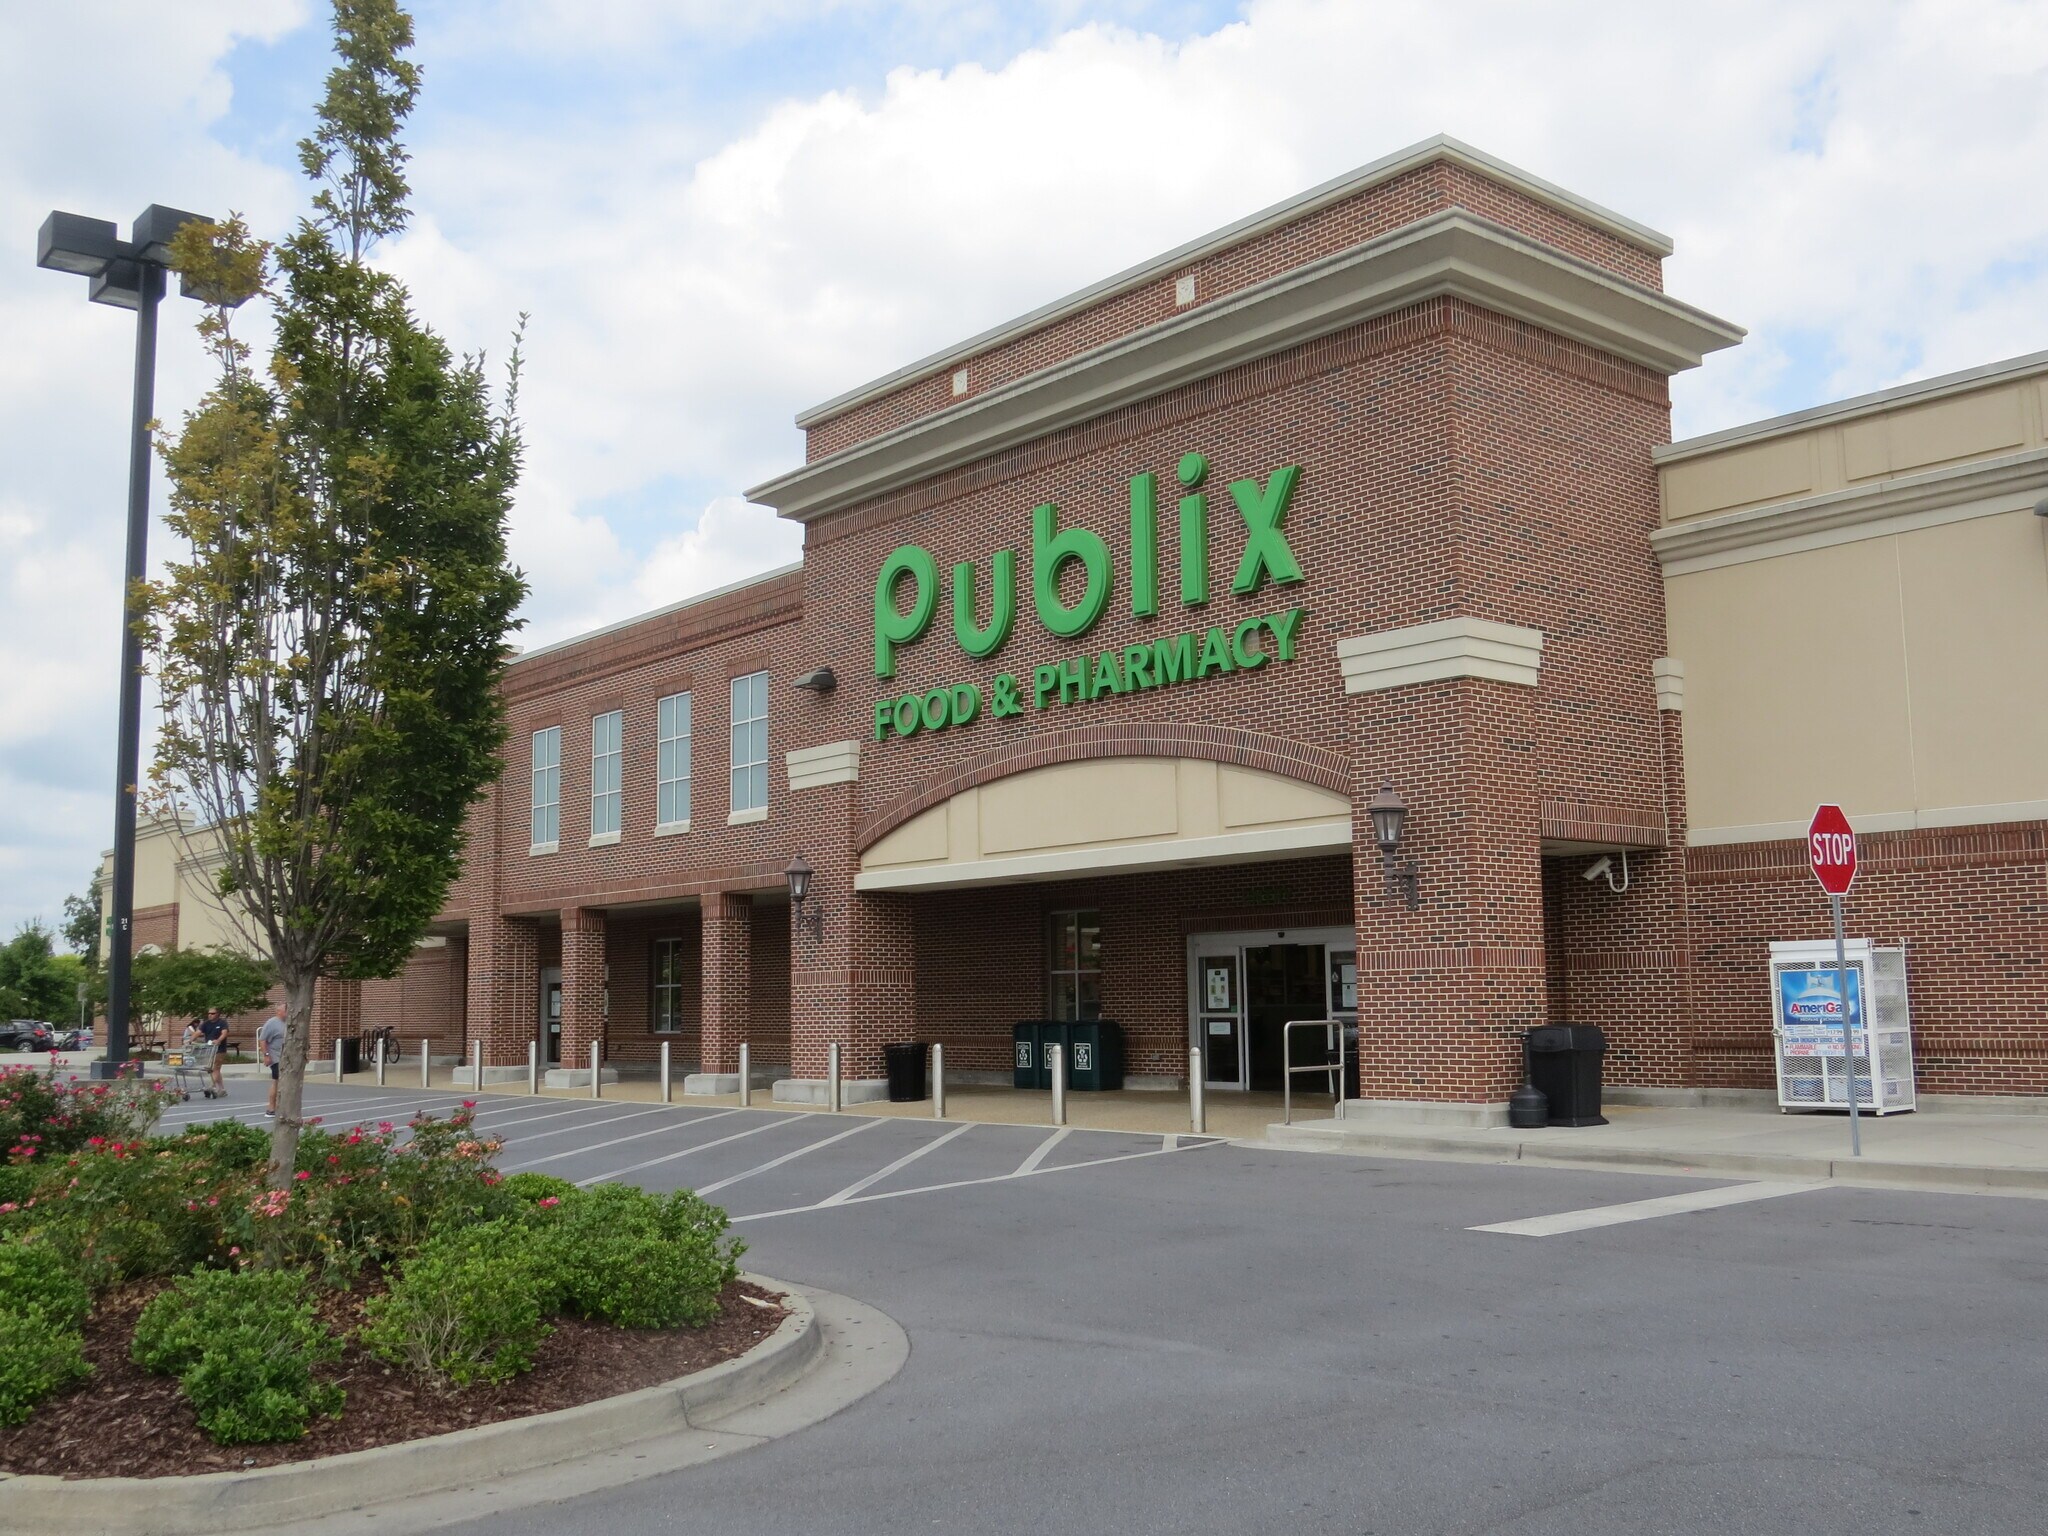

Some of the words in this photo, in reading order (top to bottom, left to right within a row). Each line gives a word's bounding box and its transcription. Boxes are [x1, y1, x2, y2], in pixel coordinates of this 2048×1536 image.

[875, 683, 982, 741] FOOD
[991, 673, 1023, 718] &
[1034, 607, 1305, 709] PHARMACY
[1813, 832, 1852, 866] STOP
[1790, 1002, 1849, 1015] AmeriGa
